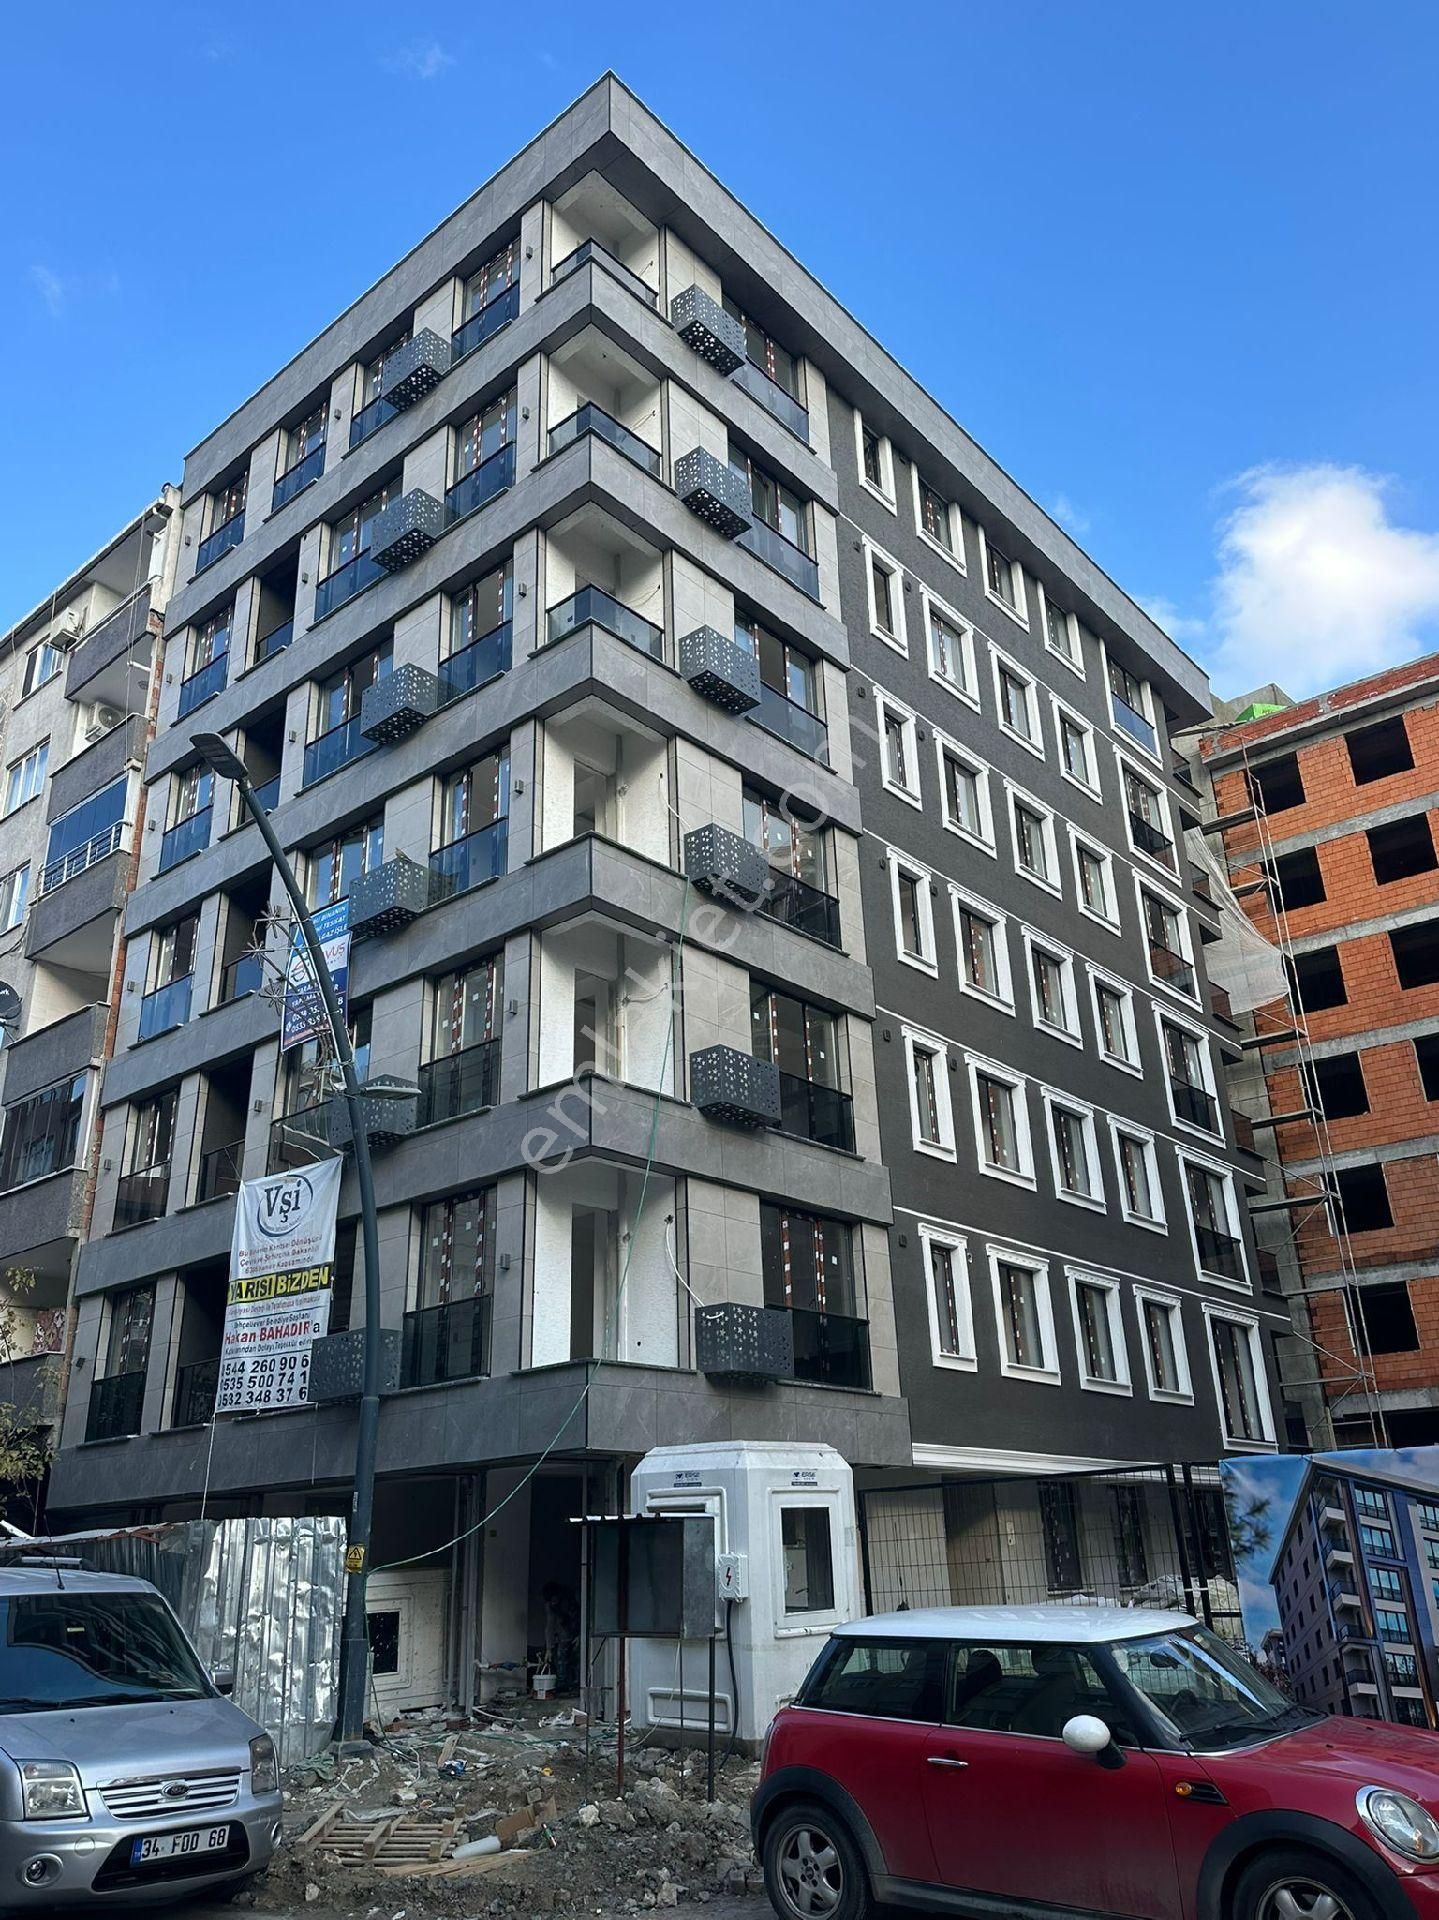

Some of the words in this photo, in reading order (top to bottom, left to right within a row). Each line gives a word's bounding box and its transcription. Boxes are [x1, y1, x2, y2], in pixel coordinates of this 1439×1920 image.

[229, 1277, 273, 1302] YARISI
[224, 1330, 256, 1345] Hakan
[250, 1358, 276, 1374] 260
[280, 1356, 297, 1371] 90
[301, 1354, 309, 1368] 6
[247, 1373, 274, 1389] 500
[278, 1371, 294, 1387] 74
[299, 1370, 307, 1384] 1
[245, 1389, 272, 1404] 348
[276, 1387, 293, 1402] 37
[299, 1386, 308, 1400] 6
[141, 1839, 160, 1859] 34
[208, 1827, 227, 1848] 68
